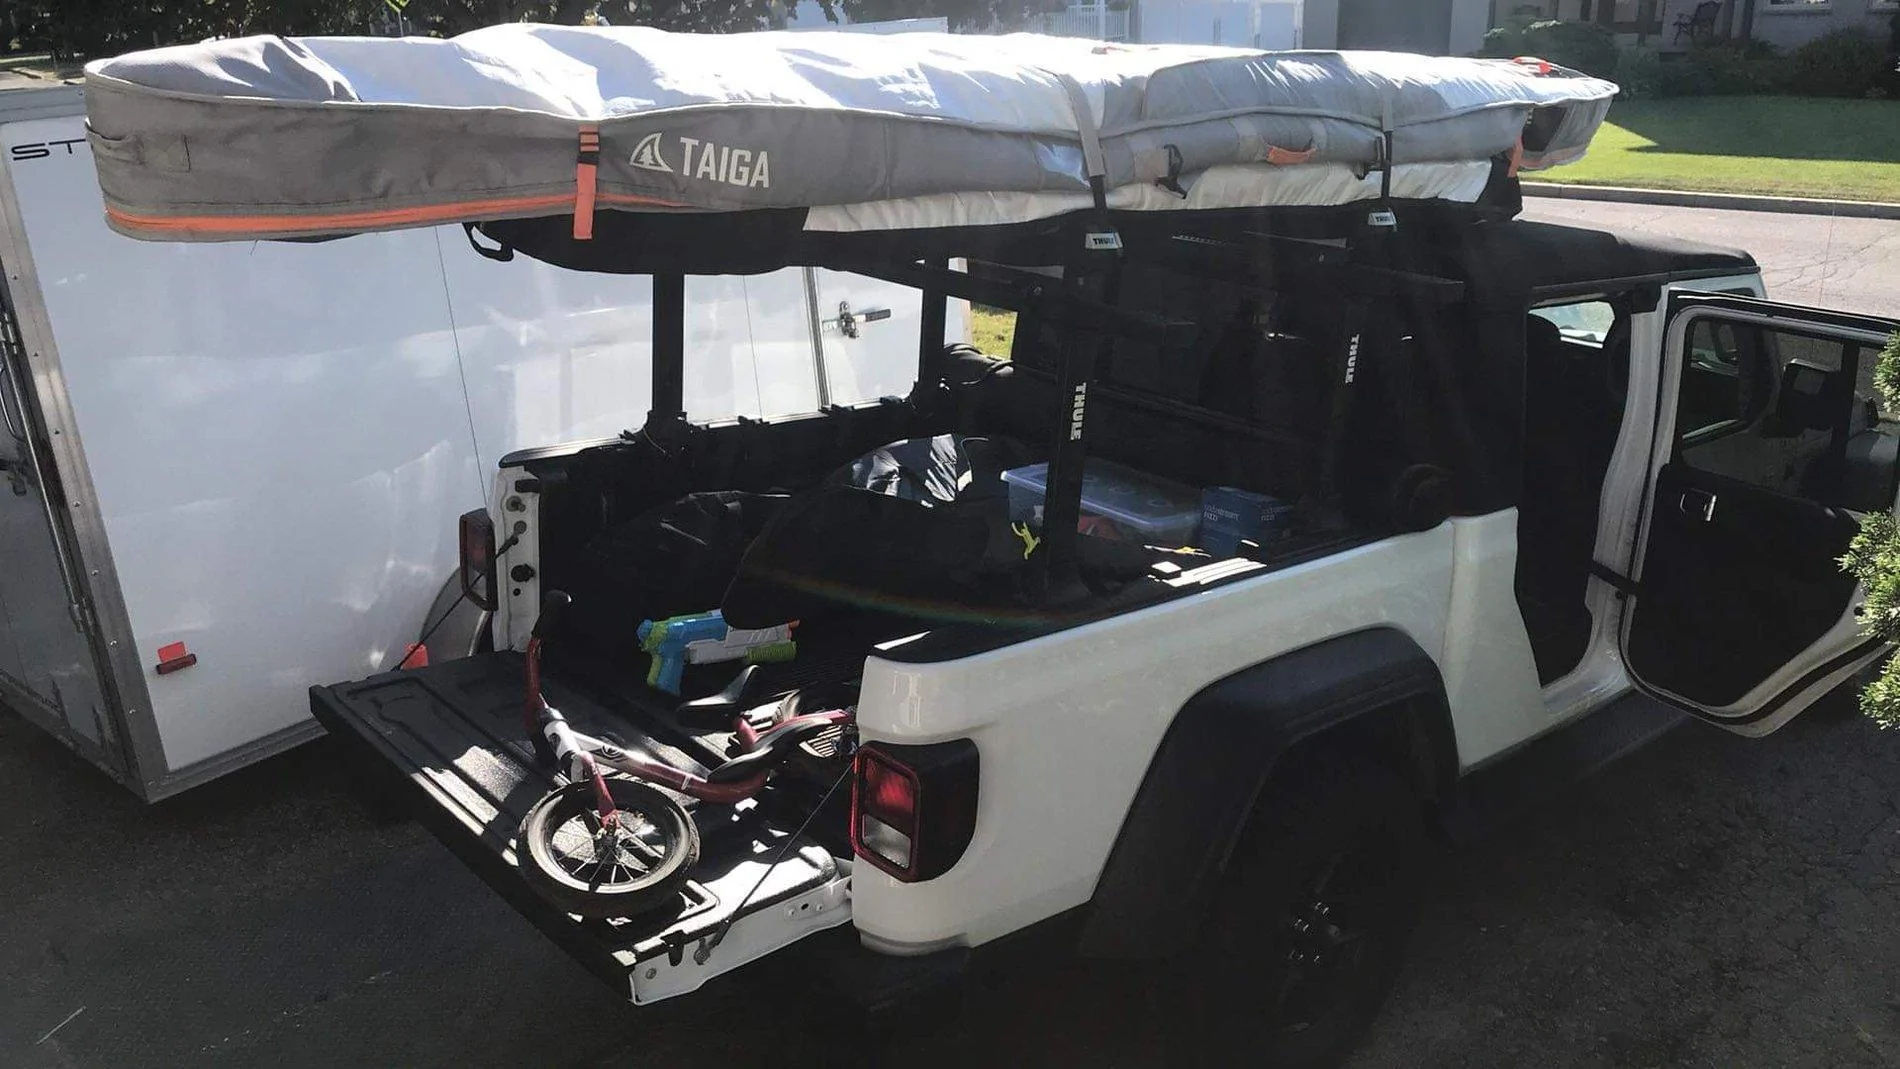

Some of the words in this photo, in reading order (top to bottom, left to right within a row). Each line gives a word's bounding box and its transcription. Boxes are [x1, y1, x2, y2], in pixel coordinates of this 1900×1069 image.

[680, 136, 770, 188] TAIGA
[1345, 333, 1360, 384] THULE
[1070, 381, 1087, 440] THULE
